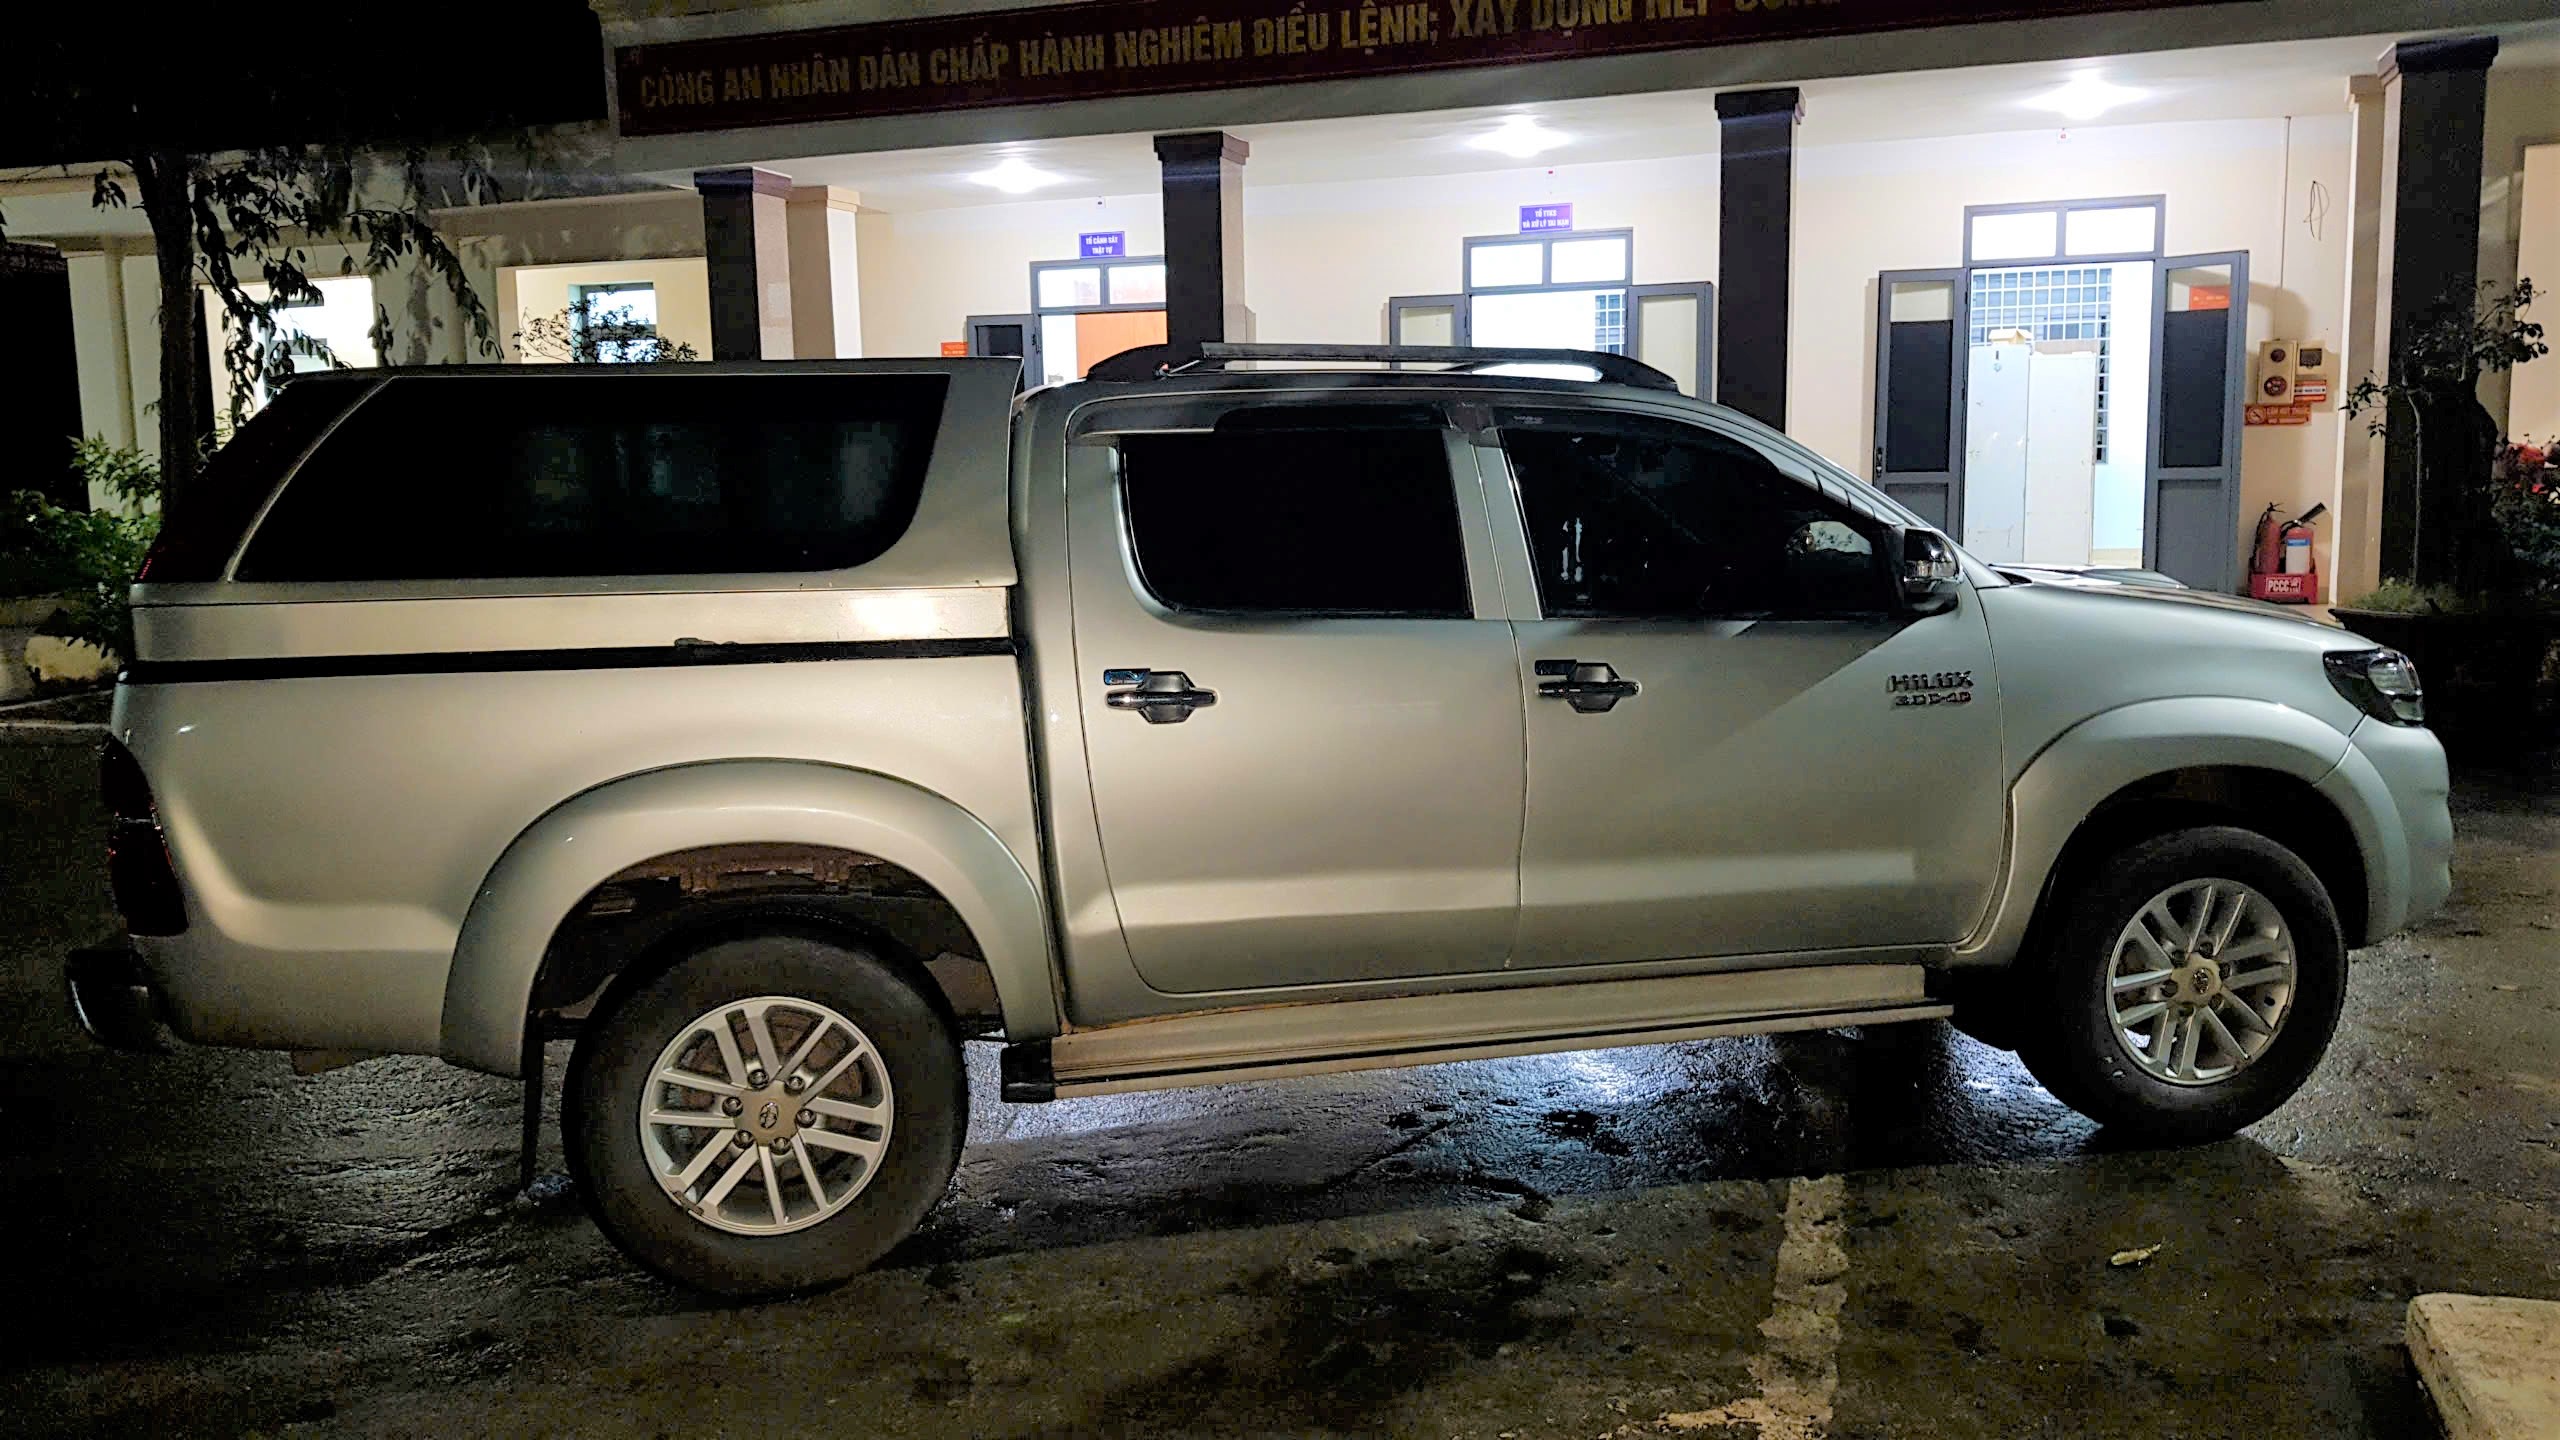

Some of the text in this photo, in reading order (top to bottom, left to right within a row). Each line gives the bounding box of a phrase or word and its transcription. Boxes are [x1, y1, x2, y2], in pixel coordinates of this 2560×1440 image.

[723, 63, 762, 101] AN
[769, 51, 850, 99] NHÂN
[857, 45, 922, 91] DÂN
[1112, 15, 1243, 69] NGHIÊM
[1886, 670, 1974, 692] HILUX
